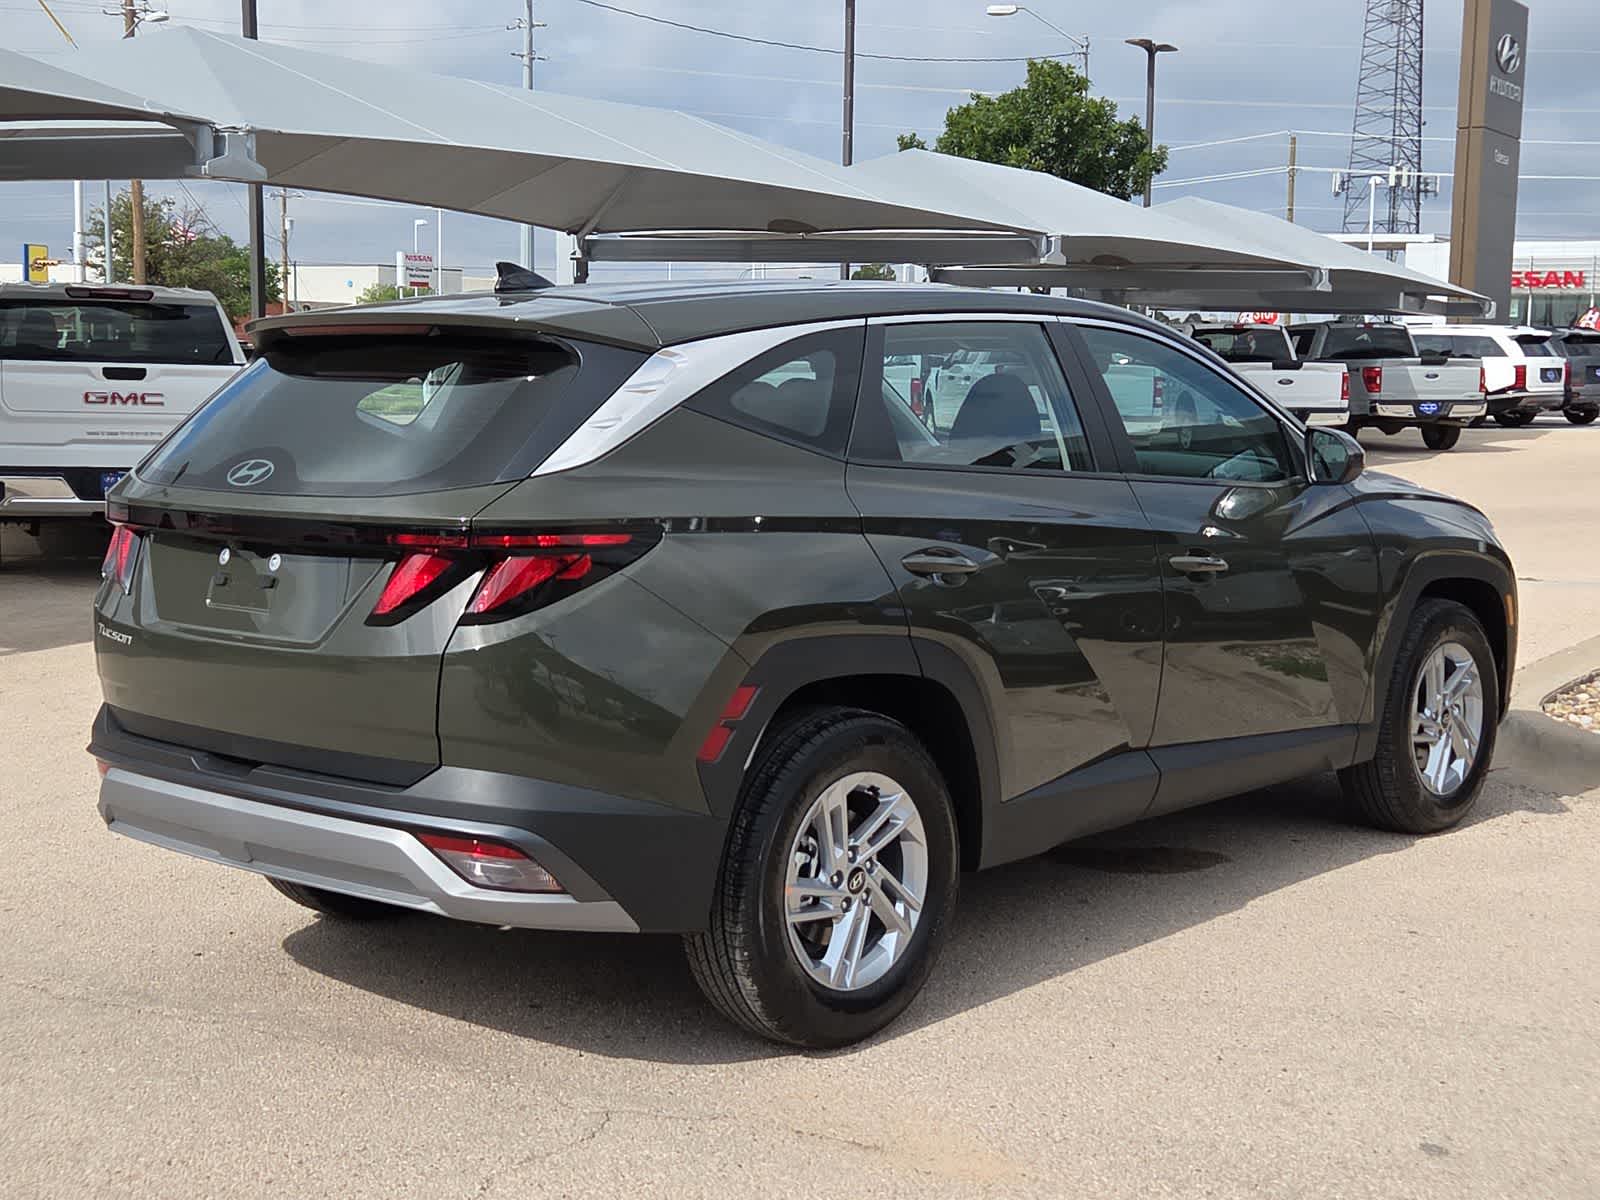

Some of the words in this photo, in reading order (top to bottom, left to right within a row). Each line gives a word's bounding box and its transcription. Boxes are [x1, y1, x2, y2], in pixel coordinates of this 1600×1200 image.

[404, 254, 432, 262] NISSAN
[84, 391, 165, 406] GMC
[98, 622, 132, 645] TUCSON
